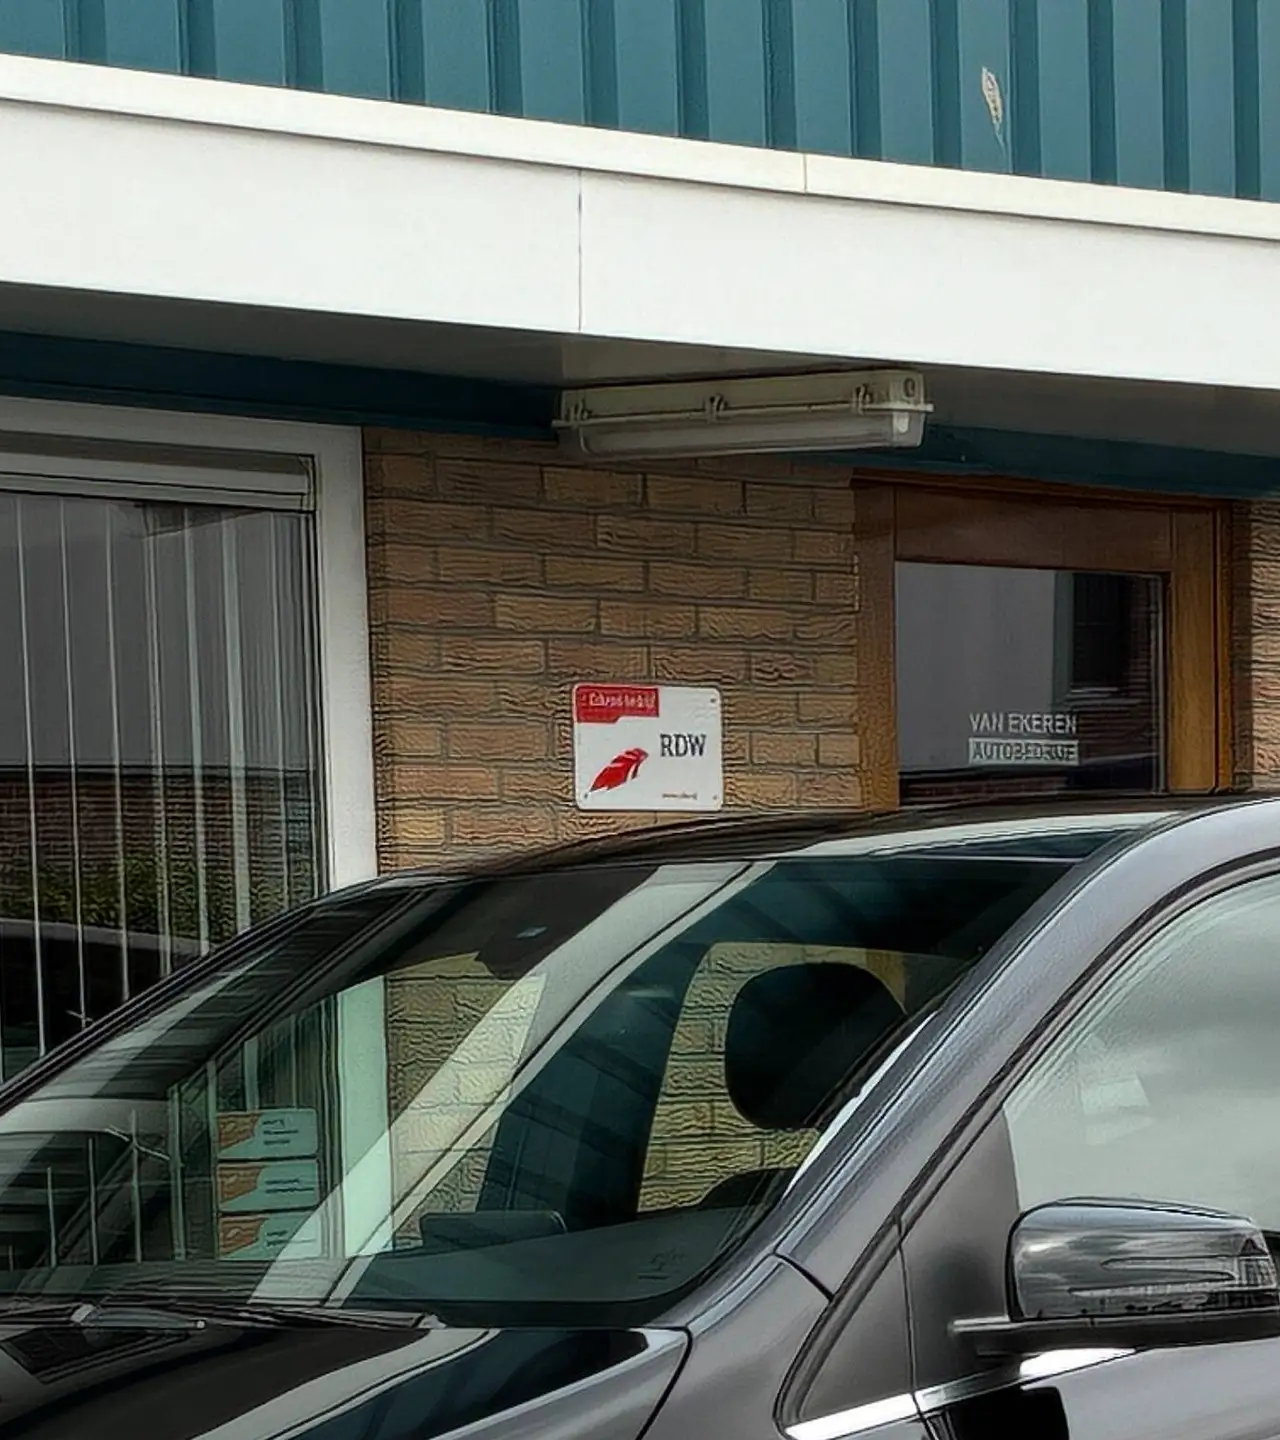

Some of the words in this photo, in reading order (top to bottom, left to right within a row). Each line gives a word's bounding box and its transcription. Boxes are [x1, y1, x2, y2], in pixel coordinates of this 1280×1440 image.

[969, 712, 1003, 734] VAN
[1008, 713, 1077, 735] EKEREN
[659, 732, 707, 758] RDW
